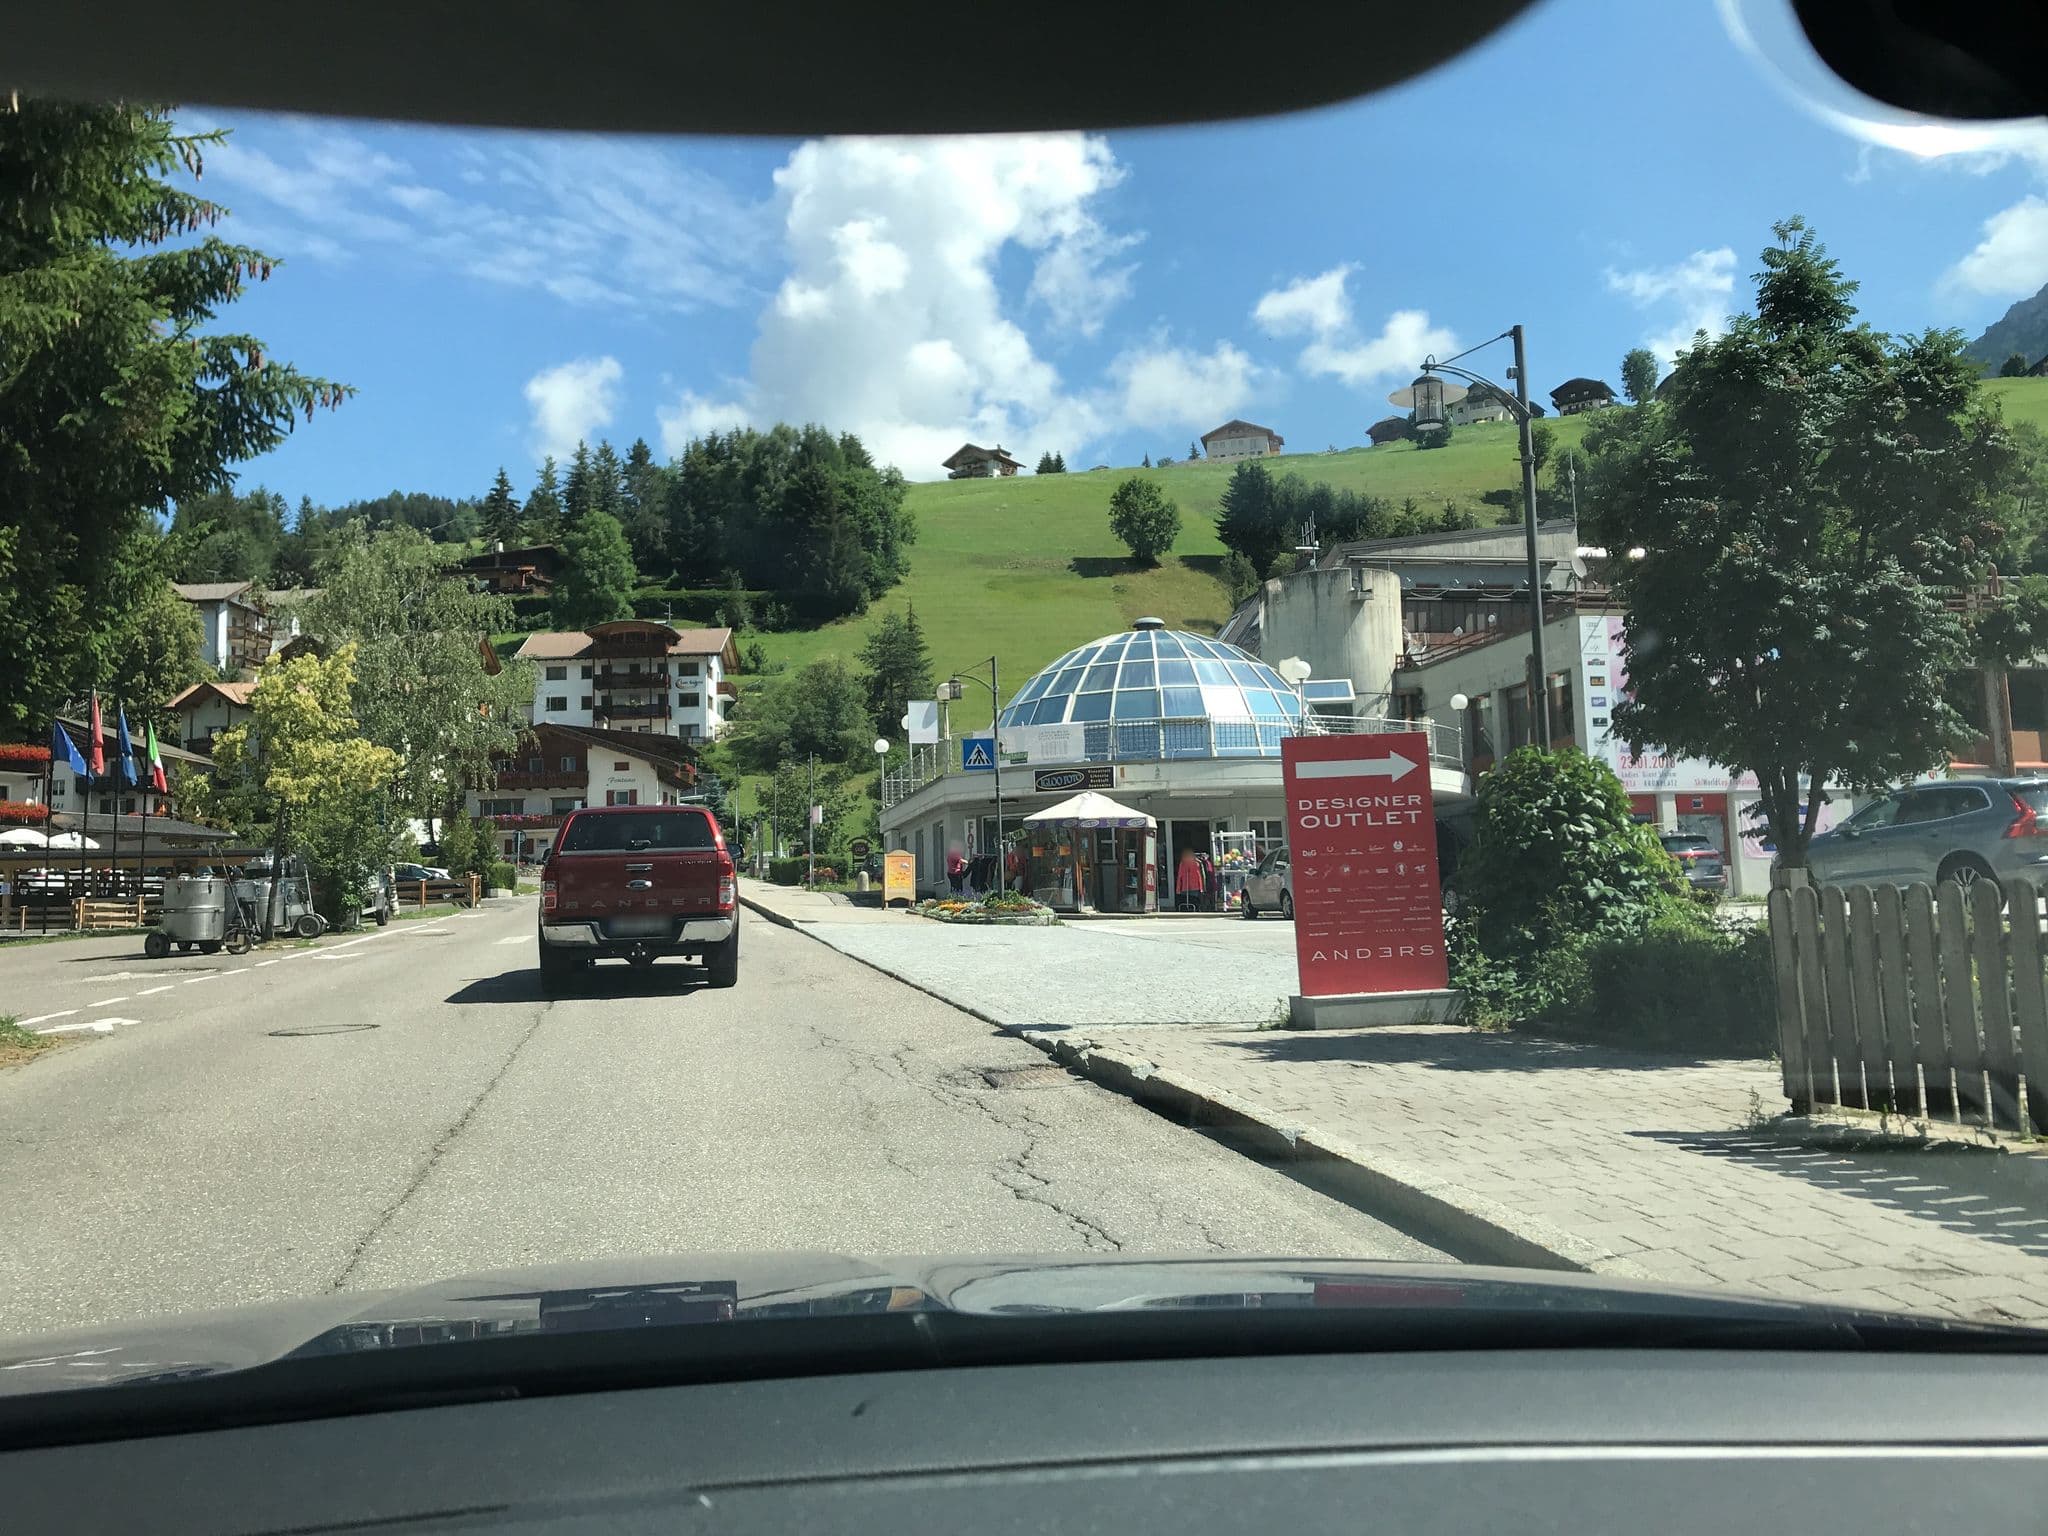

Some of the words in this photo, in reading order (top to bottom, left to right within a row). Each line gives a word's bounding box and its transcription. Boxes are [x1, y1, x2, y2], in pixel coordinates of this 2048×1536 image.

[1298, 795, 1422, 811] DESIGNER
[1300, 810, 1422, 829] OUTLET
[565, 897, 711, 909] RANGER
